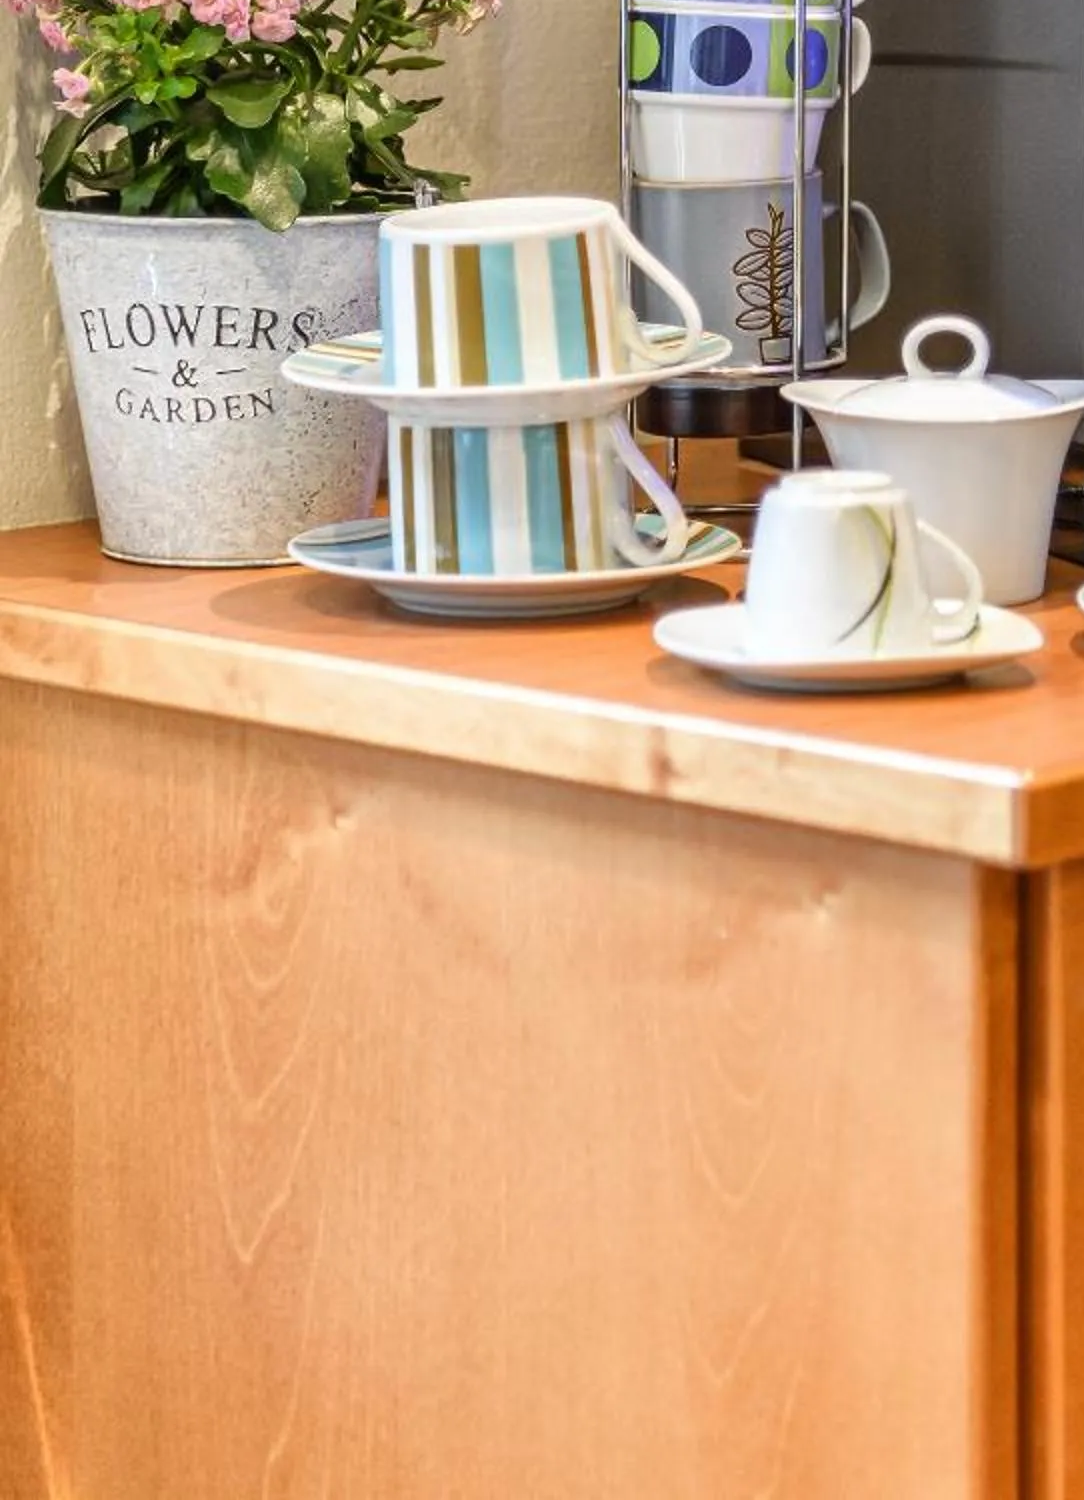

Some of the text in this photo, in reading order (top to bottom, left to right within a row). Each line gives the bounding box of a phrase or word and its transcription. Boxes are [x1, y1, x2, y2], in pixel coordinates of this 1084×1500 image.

[80, 303, 315, 352] FLOWERS
[172, 359, 199, 387] &
[115, 387, 277, 423] GARDEN
